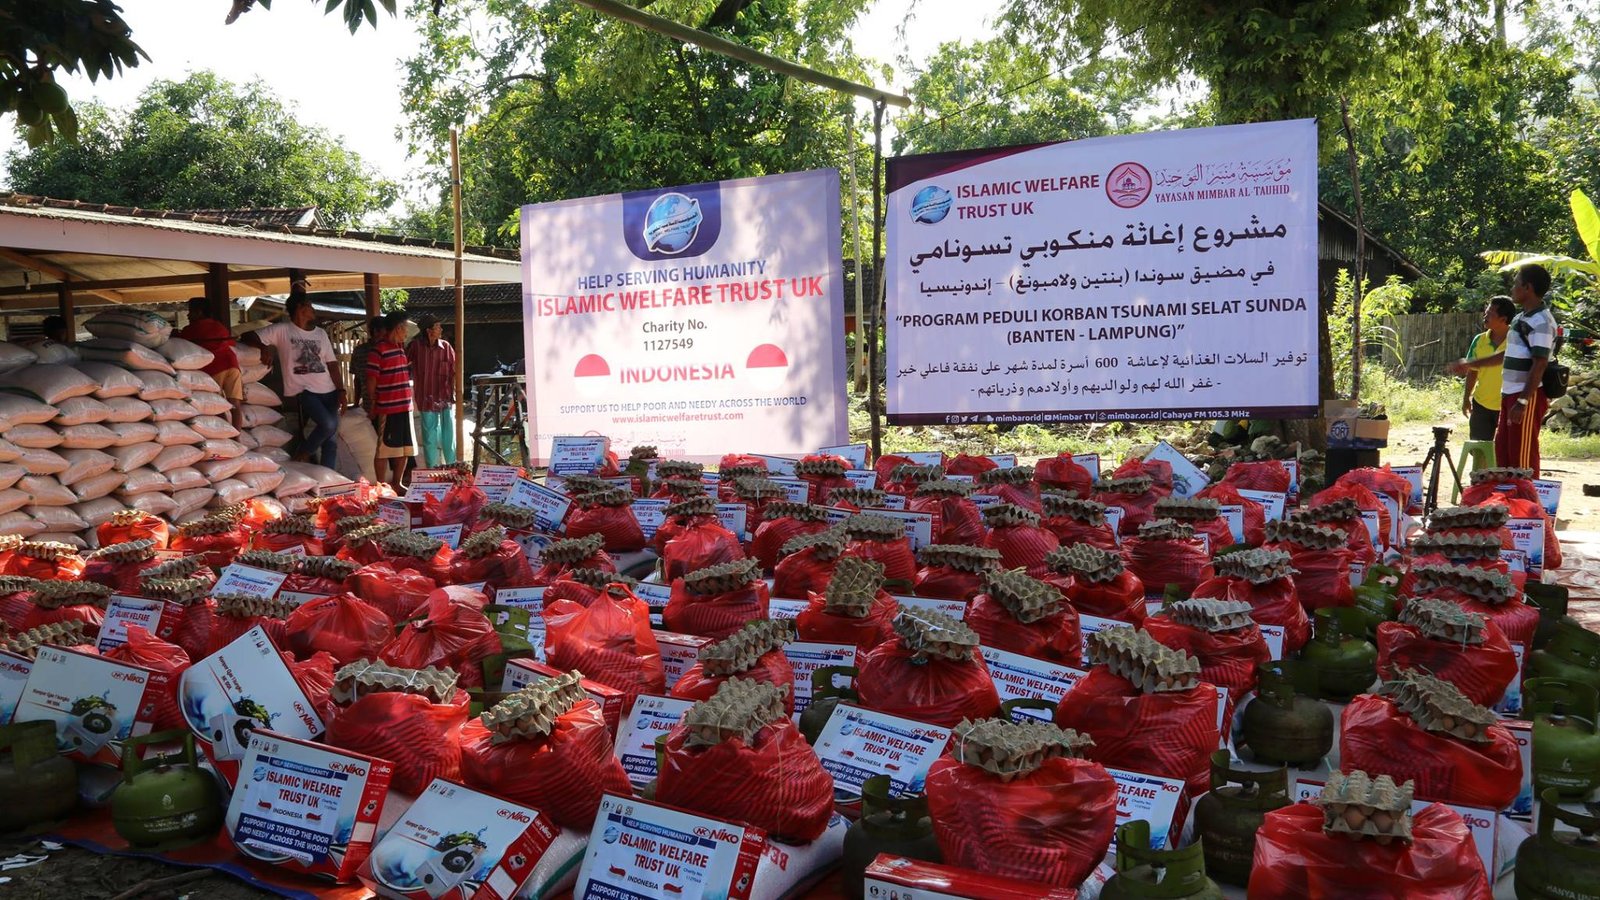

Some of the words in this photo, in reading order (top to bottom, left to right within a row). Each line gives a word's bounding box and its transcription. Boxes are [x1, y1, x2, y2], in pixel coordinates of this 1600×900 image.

[957, 181, 1022, 199] ISLAMIC
[1025, 174, 1100, 193] WELFARE
[1155, 192, 1195, 203] YAYASAN
[1197, 188, 1236, 200] MIMBAR
[957, 203, 1007, 220] TRUST
[1011, 201, 1034, 216] UK
[1122, 221, 1185, 254] إغاثة
[1193, 214, 1287, 252] مشروع
[910, 235, 1012, 274] تسونامي
[1020, 229, 1114, 268] منكوبي
[578, 273, 613, 290] HELP
[617, 267, 680, 287] SERVING
[683, 260, 767, 281] HUMANITY
[1135, 269, 1185, 286] سوندا
[1190, 265, 1246, 285] مضيق
[1250, 260, 1275, 286] في
[920, 277, 992, 297] إندونيسيا
[538, 292, 615, 317] ISLAMIC
[619, 284, 713, 310] WELFARE
[717, 279, 785, 303] TRUST
[791, 276, 824, 297] UK
[983, 309, 1038, 325] PEDULI
[1042, 306, 1108, 322] KORBAN
[1111, 302, 1187, 319] TSUNAMI
[1191, 300, 1241, 316] SELAT
[1245, 297, 1307, 313] SUNDA
[642, 320, 686, 334] Charity
[687, 319, 708, 331] No.
[643, 337, 694, 352] 1127549
[1007, 328, 1076, 346] (BANTEN
[1031, 359, 1058, 371] لمدة
[1060, 356, 1089, 374] أسرة
[1095, 357, 1119, 368] 600
[1224, 351, 1268, 365] السلات
[1272, 350, 1308, 367] توفير
[620, 361, 736, 384] INDONESIA
[1004, 360, 1029, 376] شهر
[1141, 378, 1161, 392] لهم
[1164, 377, 1185, 389] الله
[1189, 377, 1213, 393] غفر
[560, 404, 595, 414] SUPPORT
[597, 403, 608, 413] US
[609, 403, 619, 412] TO
[621, 402, 642, 412] HELP
[643, 401, 666, 411] POOR
[668, 401, 687, 411] AND
[689, 400, 718, 410] NEEDY
[719, 398, 753, 408] ACROSS
[755, 398, 772, 407] THE
[774, 396, 807, 406] WORLD
[612, 411, 744, 424] www.islamicwelfaretrust.com
[995, 414, 1041, 422] mimbarorid
[1052, 413, 1082, 421] Mimbar
[1107, 411, 1159, 420] mimbar.or.id
[1162, 411, 1193, 420] Cahaya
[1208, 410, 1230, 418] 105.3
[991, 670, 1025, 685] ISLAMIC
[1027, 678, 1067, 696] WELFARE
[1005, 684, 1031, 697] TRUST
[650, 720, 676, 731] ISLAM
[853, 727, 886, 743] ISLAMIC
[887, 737, 927, 756] WELFARE
[862, 742, 890, 757] TRUST
[888, 750, 903, 761] UK
[266, 771, 301, 789] ISLAMIC
[303, 778, 343, 798] WELFARE
[1117, 783, 1158, 799] ELFARE
[278, 789, 307, 805] TRUST
[307, 795, 320, 808] UK
[272, 808, 303, 820] INDONESIA
[243, 816, 267, 829] SUPPORT
[267, 822, 276, 831] US
[276, 824, 284, 833] TO
[284, 826, 299, 836] HELP
[300, 830, 312, 840] THE
[312, 833, 330, 844] POOR
[661, 828, 694, 842] HUMANITY
[239, 825, 252, 836] AND
[251, 828, 269, 840] NEEDY
[269, 834, 293, 846] ACROSS
[294, 839, 306, 849] THE
[306, 842, 328, 854] WORLD
[618, 832, 657, 853] ISLAMIC
[659, 842, 709, 869] WELFARE
[634, 854, 665, 874] TRUST
[665, 862, 681, 879] UK
[591, 883, 620, 899] SUPPORT
[627, 875, 659, 891] INDONESIA
